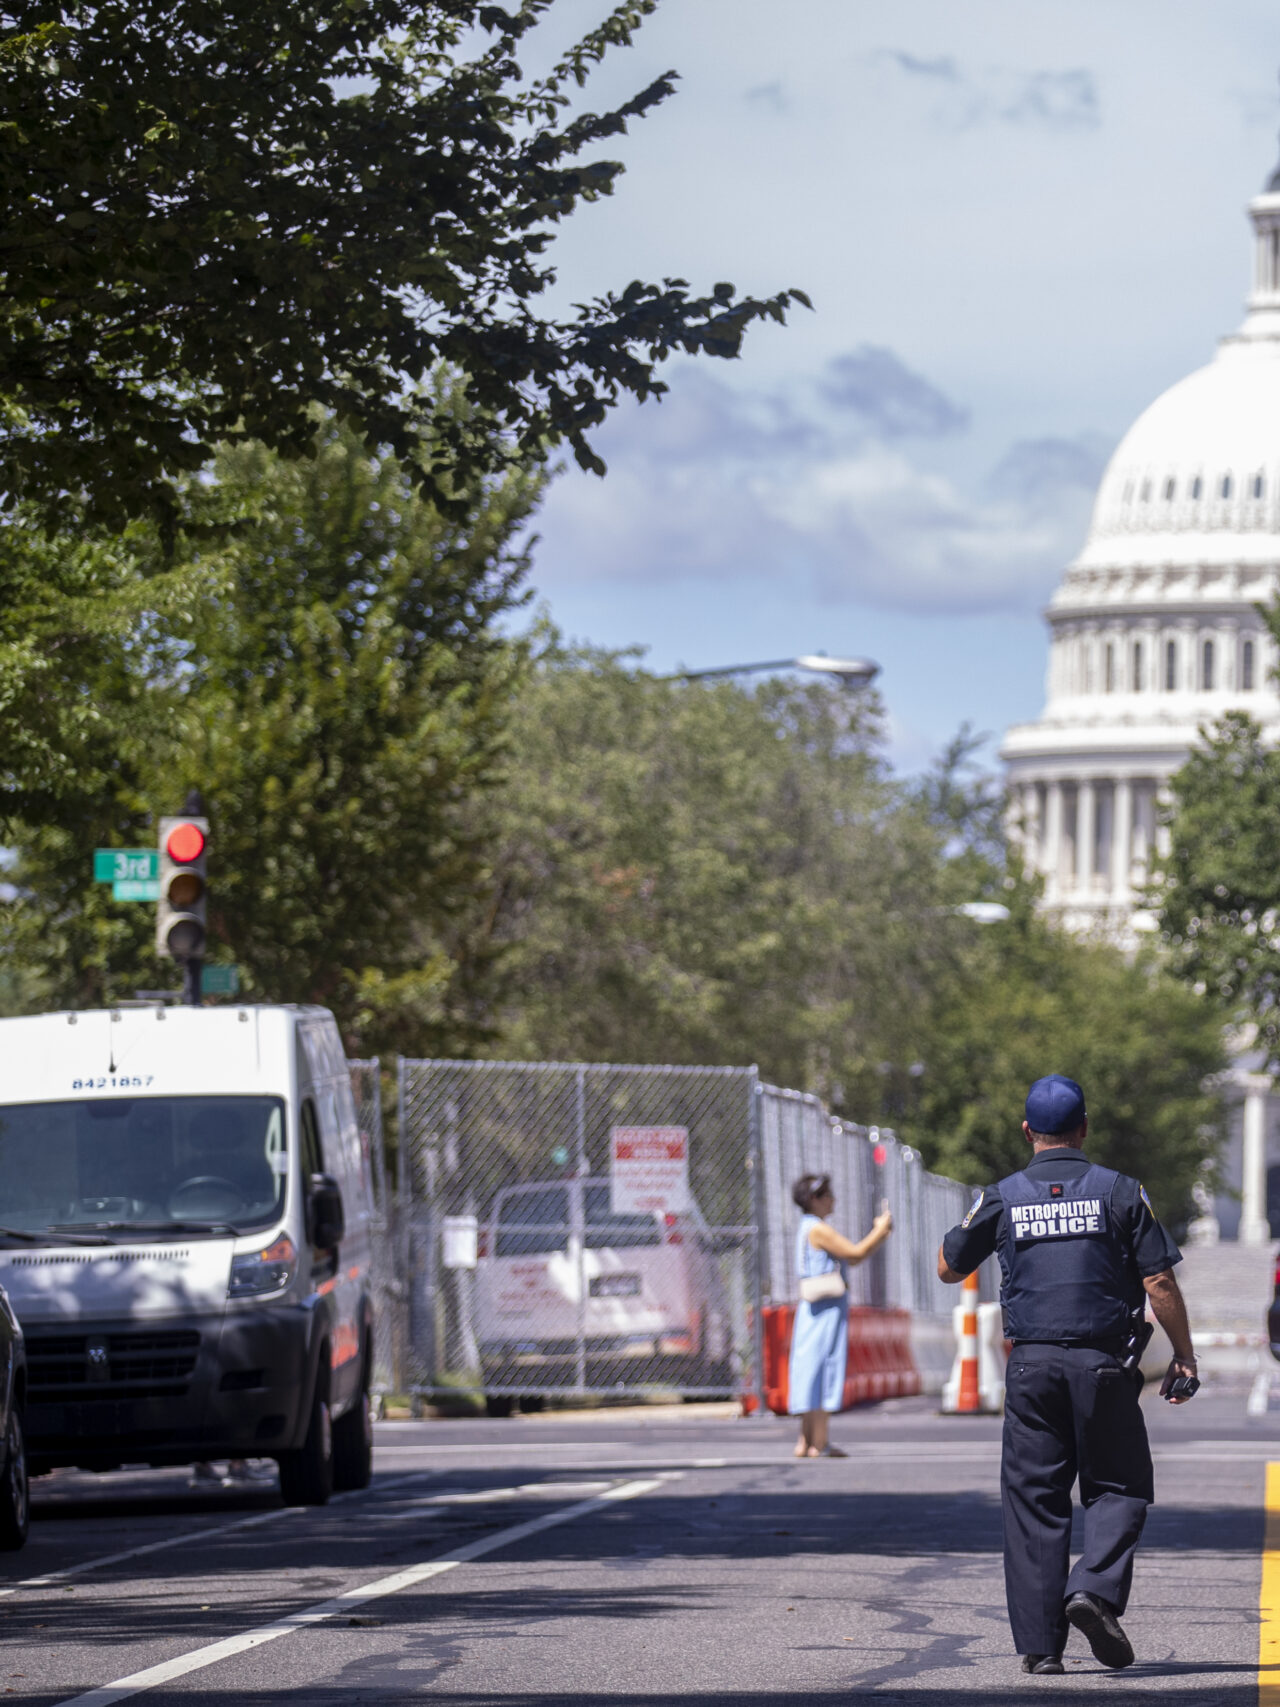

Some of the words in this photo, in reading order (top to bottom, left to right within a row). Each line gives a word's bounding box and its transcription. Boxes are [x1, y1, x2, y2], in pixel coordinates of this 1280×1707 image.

[114, 853, 151, 879] 3rd
[1011, 1199, 1101, 1223] METROPOLITAN
[1015, 1216, 1100, 1239] POLICE
